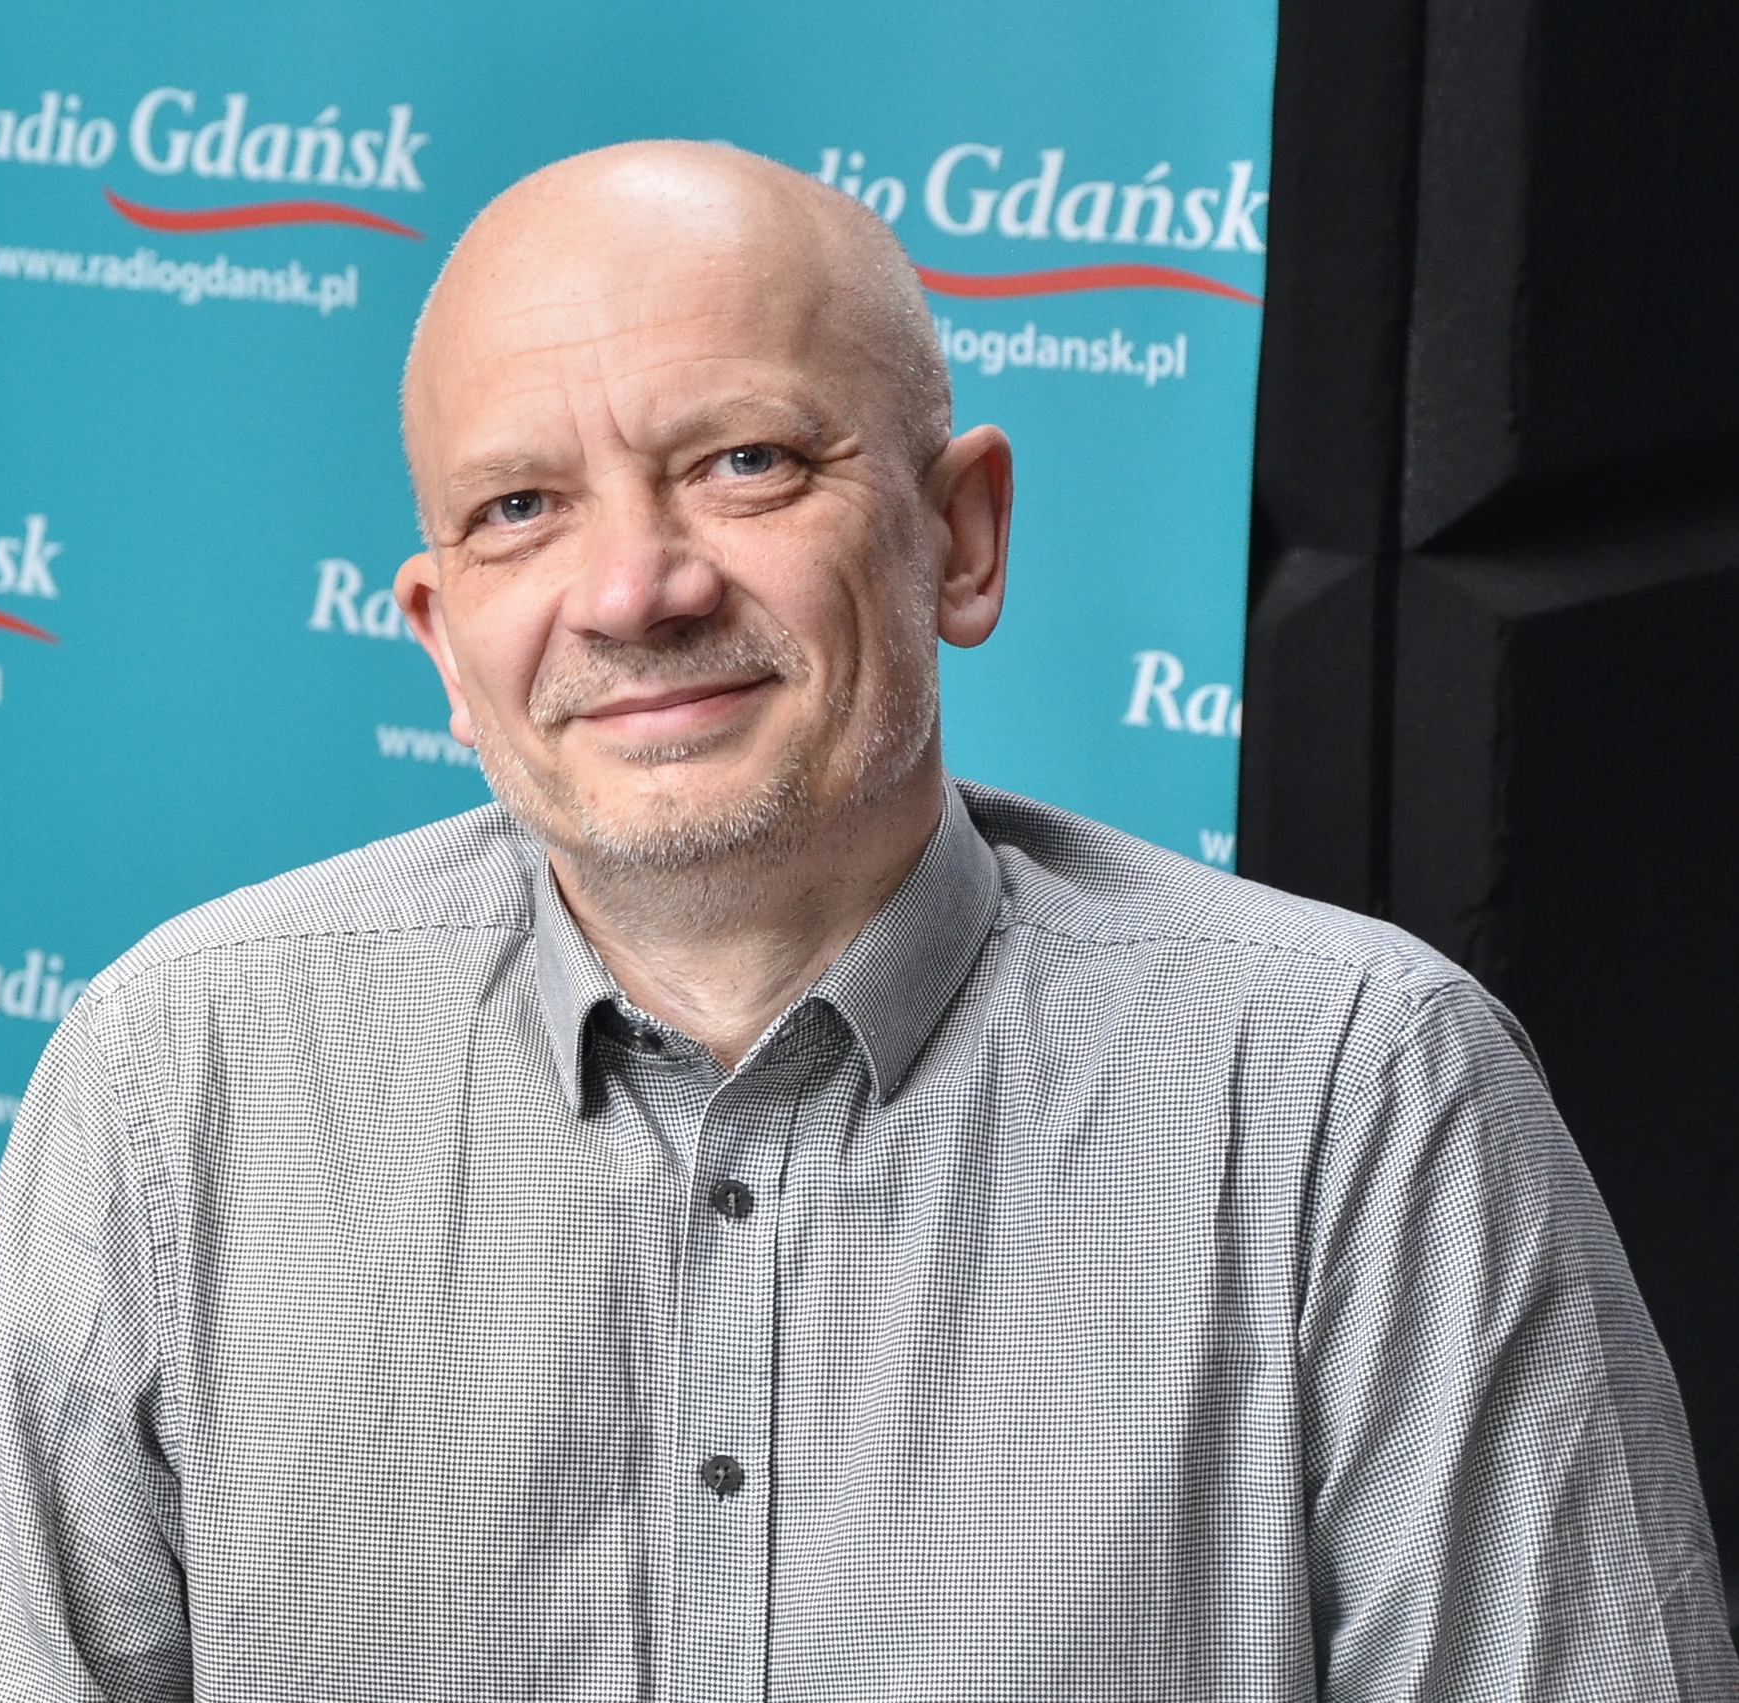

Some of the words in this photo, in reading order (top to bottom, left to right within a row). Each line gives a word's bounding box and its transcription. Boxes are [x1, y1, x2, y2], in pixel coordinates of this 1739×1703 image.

[128, 86, 429, 191] Gdańsk
[925, 143, 1268, 252] Gdańsk
[935, 315, 1187, 388] iogdansk.pl
[308, 557, 418, 642] Ra
[1122, 649, 1242, 737] Ra
